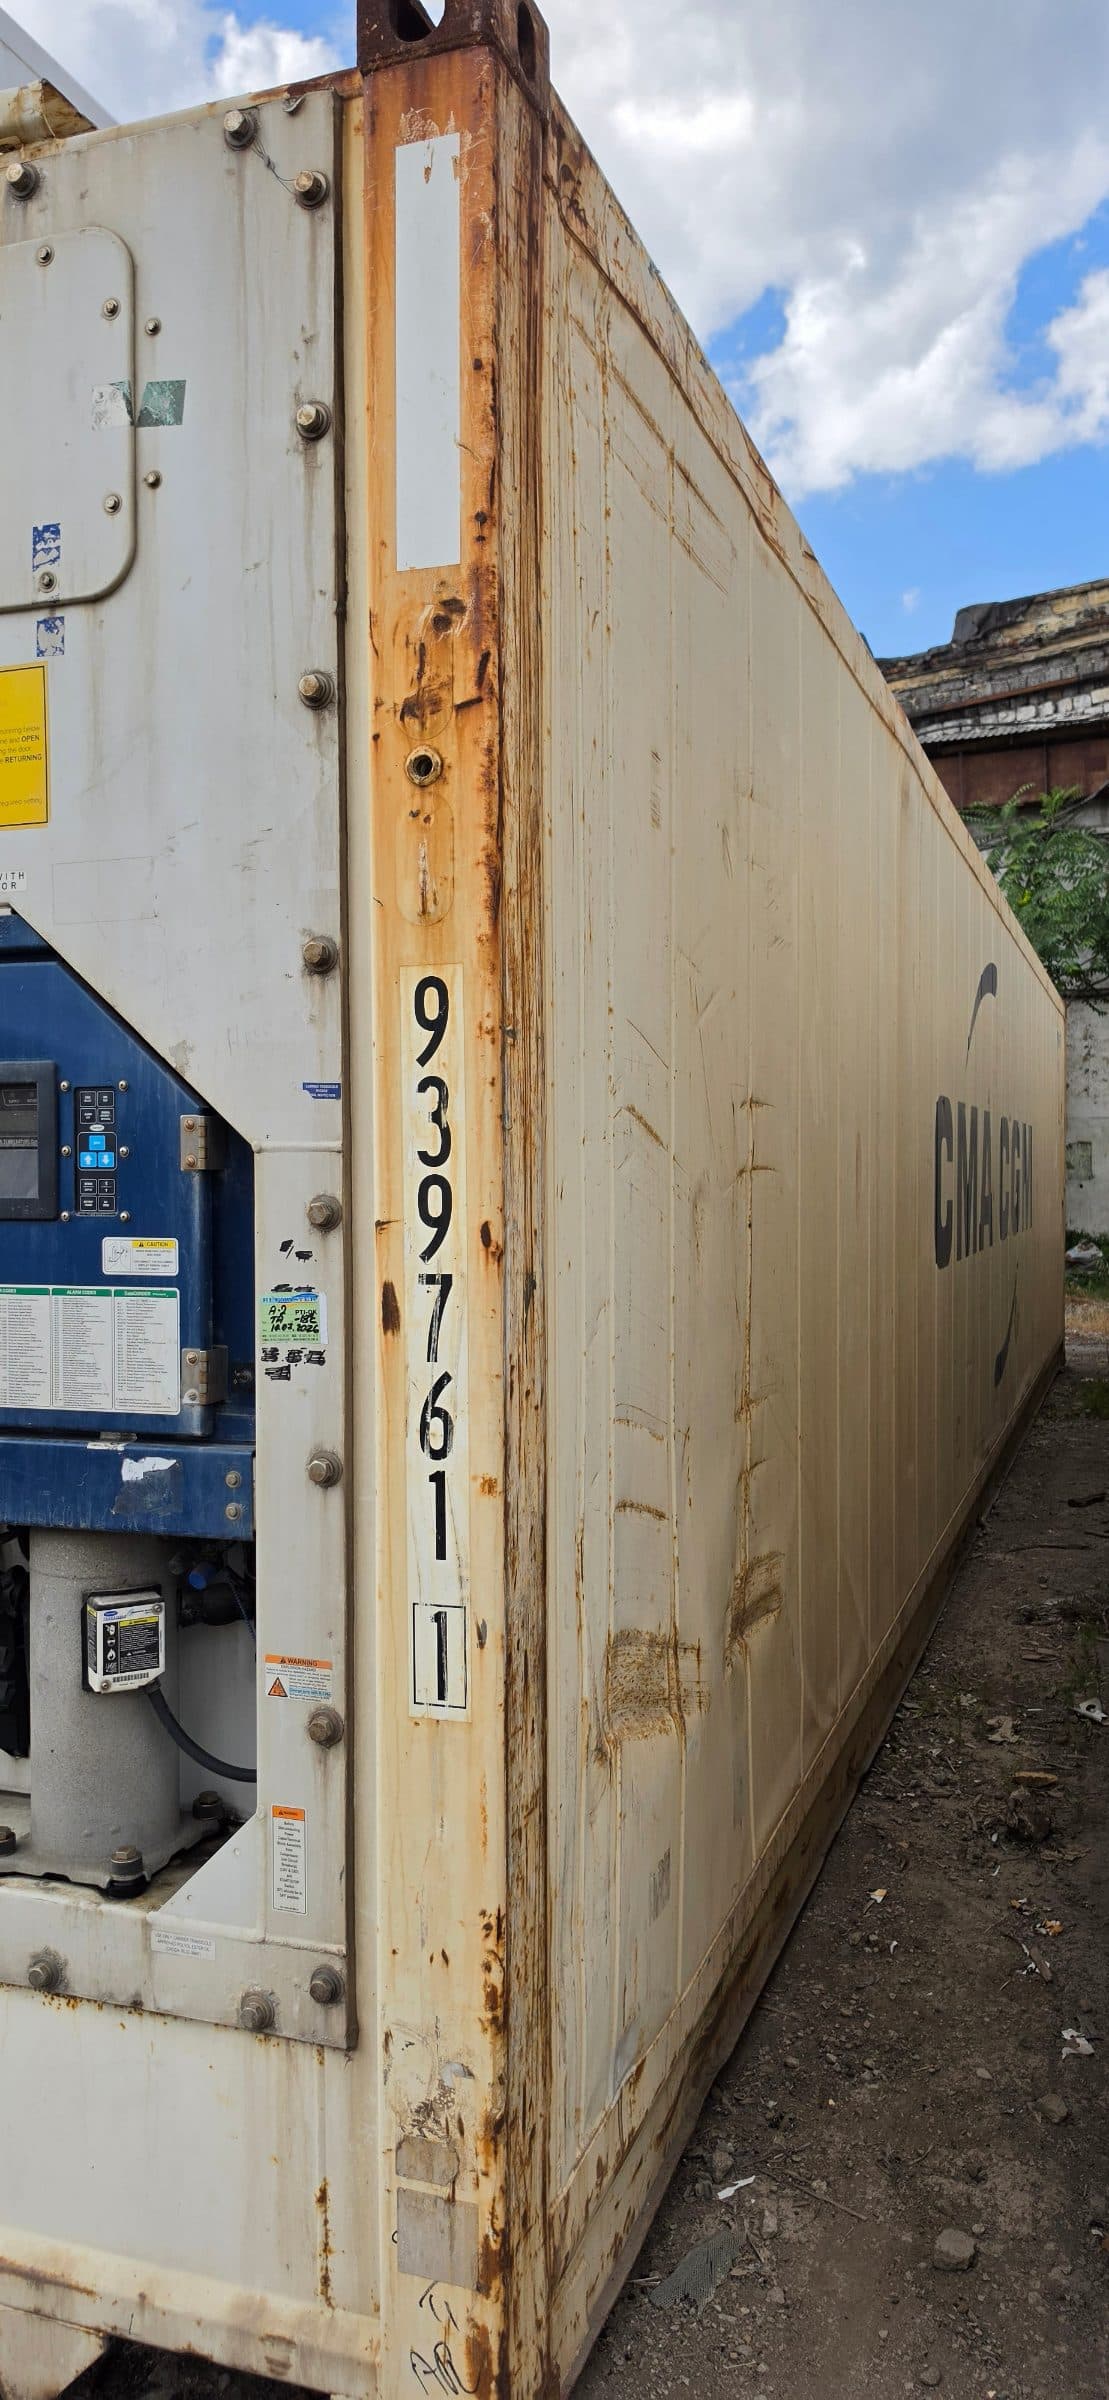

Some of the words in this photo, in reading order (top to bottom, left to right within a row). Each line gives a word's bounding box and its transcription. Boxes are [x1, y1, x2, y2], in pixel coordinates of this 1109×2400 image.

[21, 734, 40, 743] OPEN
[4, 753, 42, 764] RETURNING
[934, 1095, 993, 1269] CMA
[999, 1116, 1033, 1240] CGM
[414, 974, 454, 1561] 939761
[287, 1657, 318, 1667] WARNING
